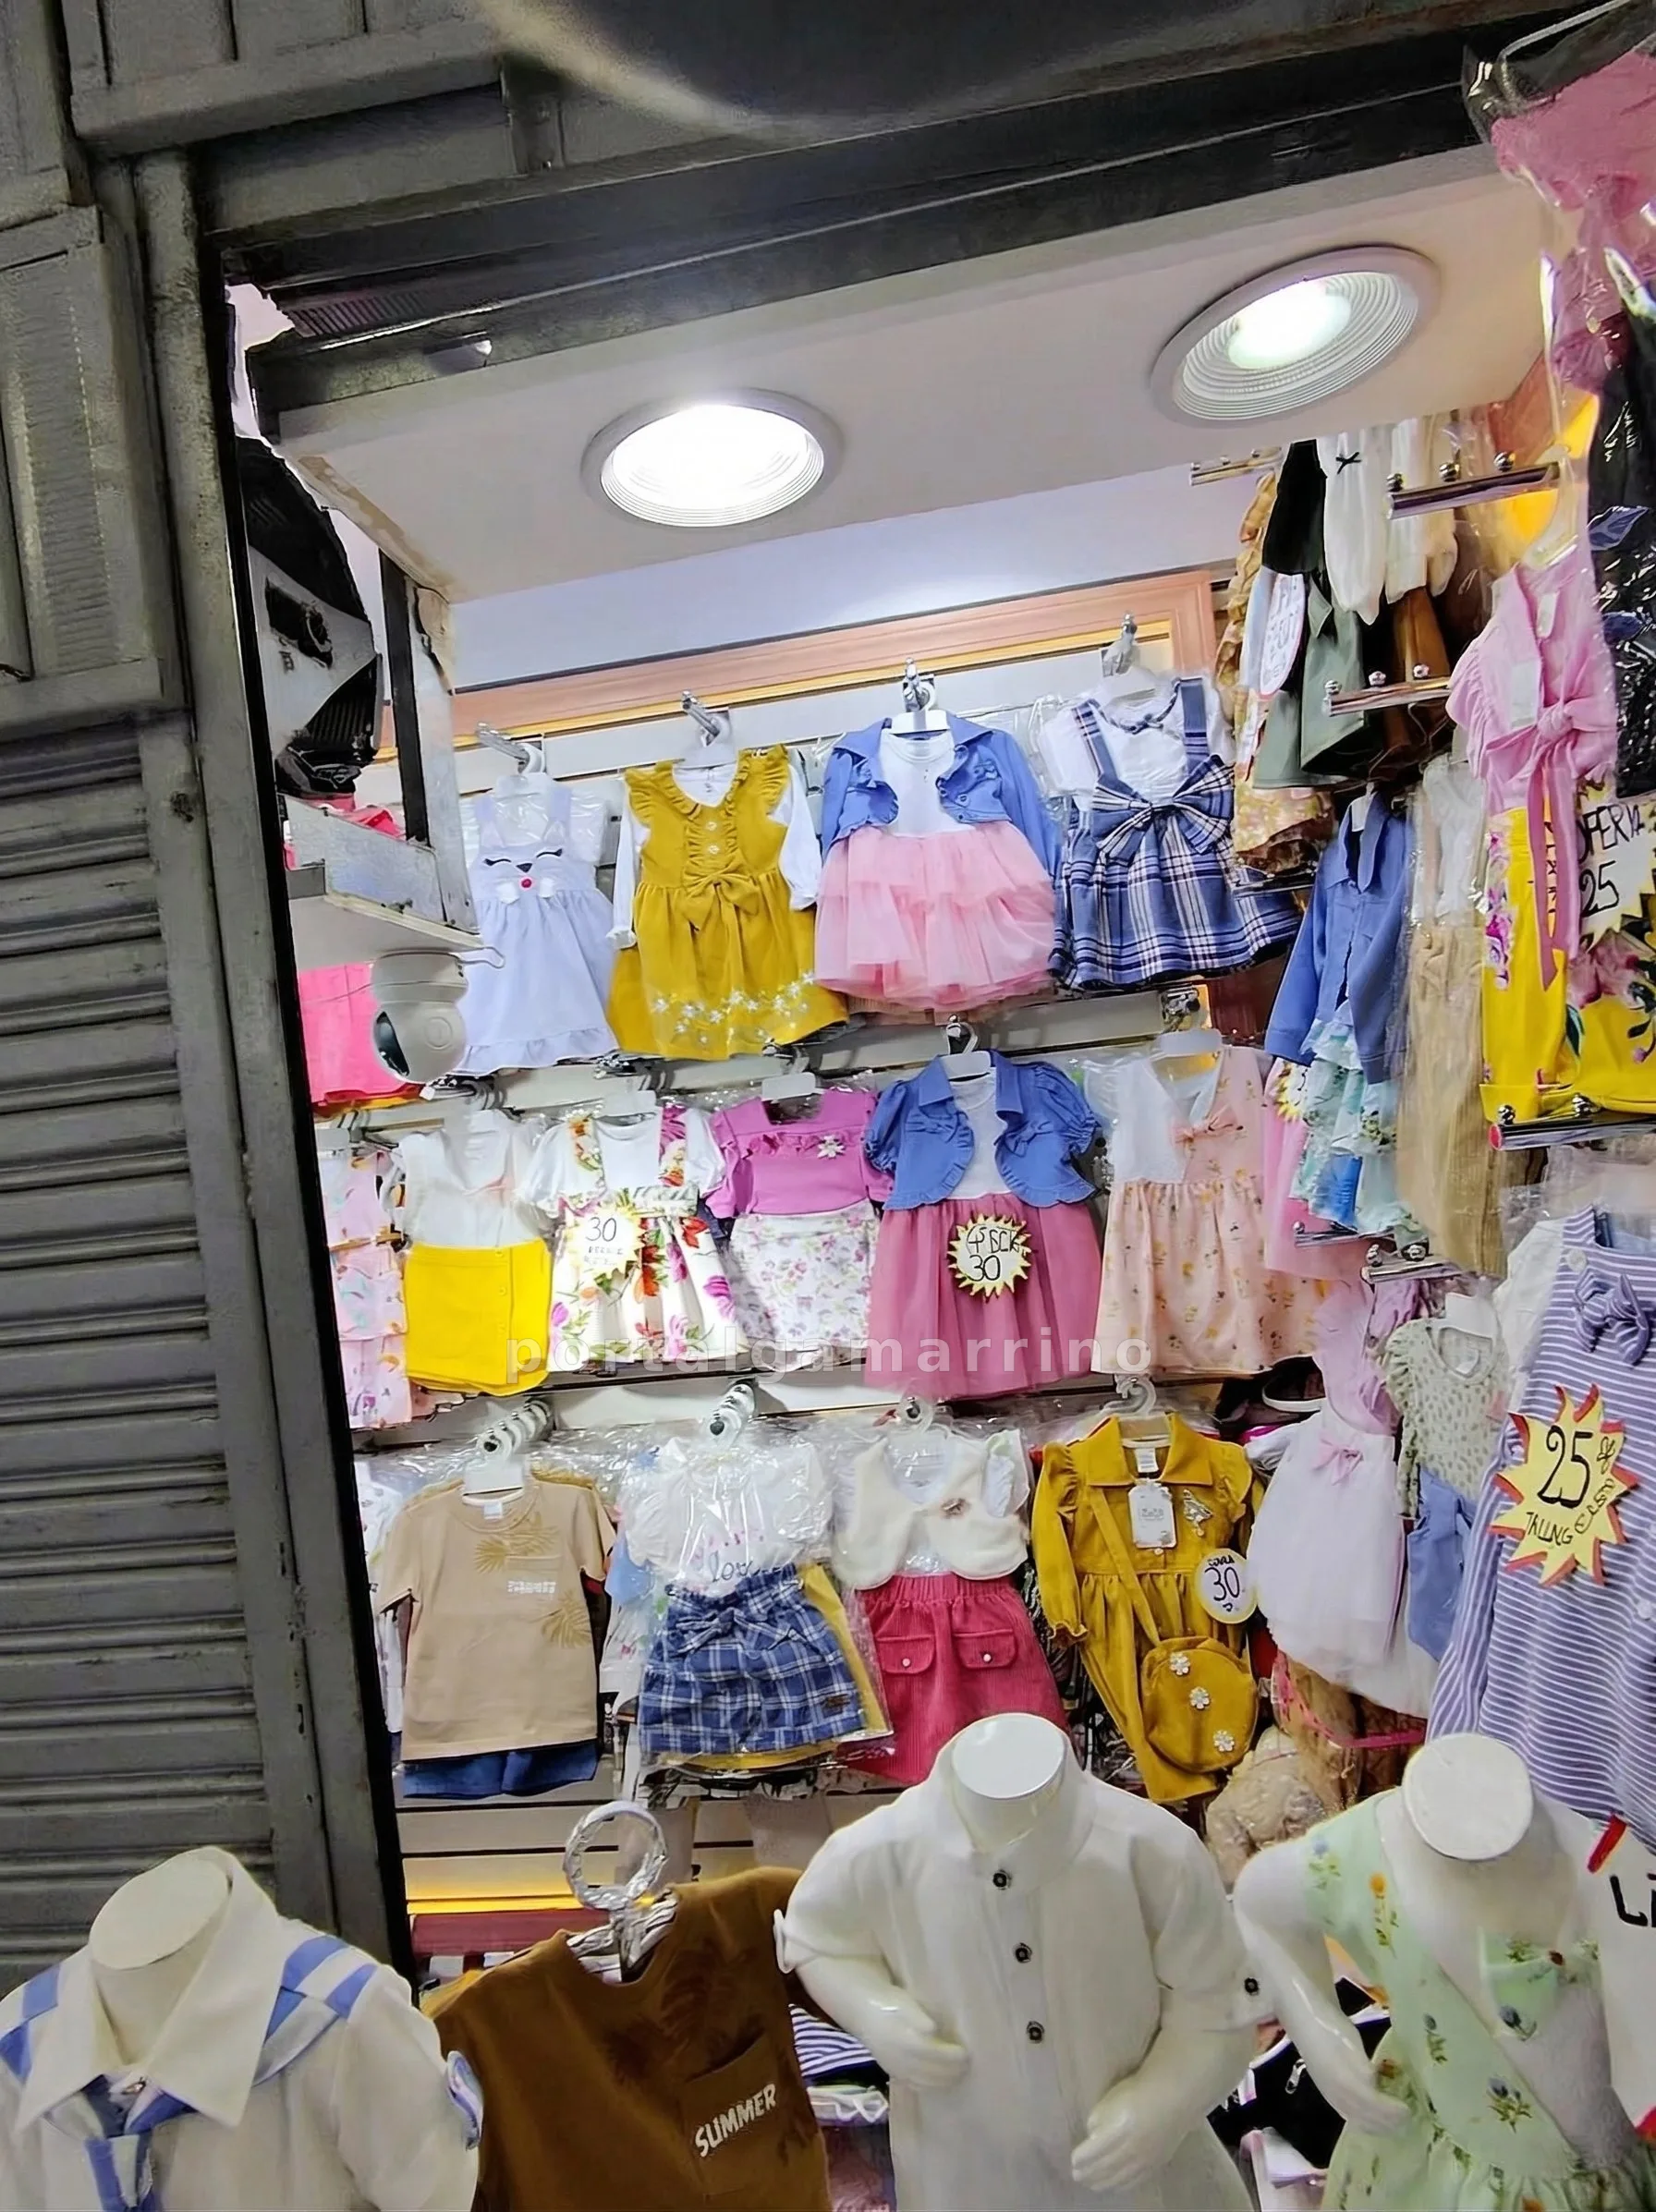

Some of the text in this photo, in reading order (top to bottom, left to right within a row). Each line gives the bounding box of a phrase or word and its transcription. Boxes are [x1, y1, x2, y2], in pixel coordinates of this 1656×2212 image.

[1578, 860, 1620, 918] 25
[585, 1216, 617, 1243] 30
[968, 1255, 1001, 1282] 30
[1537, 1424, 1594, 1510] 25
[1204, 1566, 1241, 1602] 30
[695, 2083, 777, 2158] SUMMER
